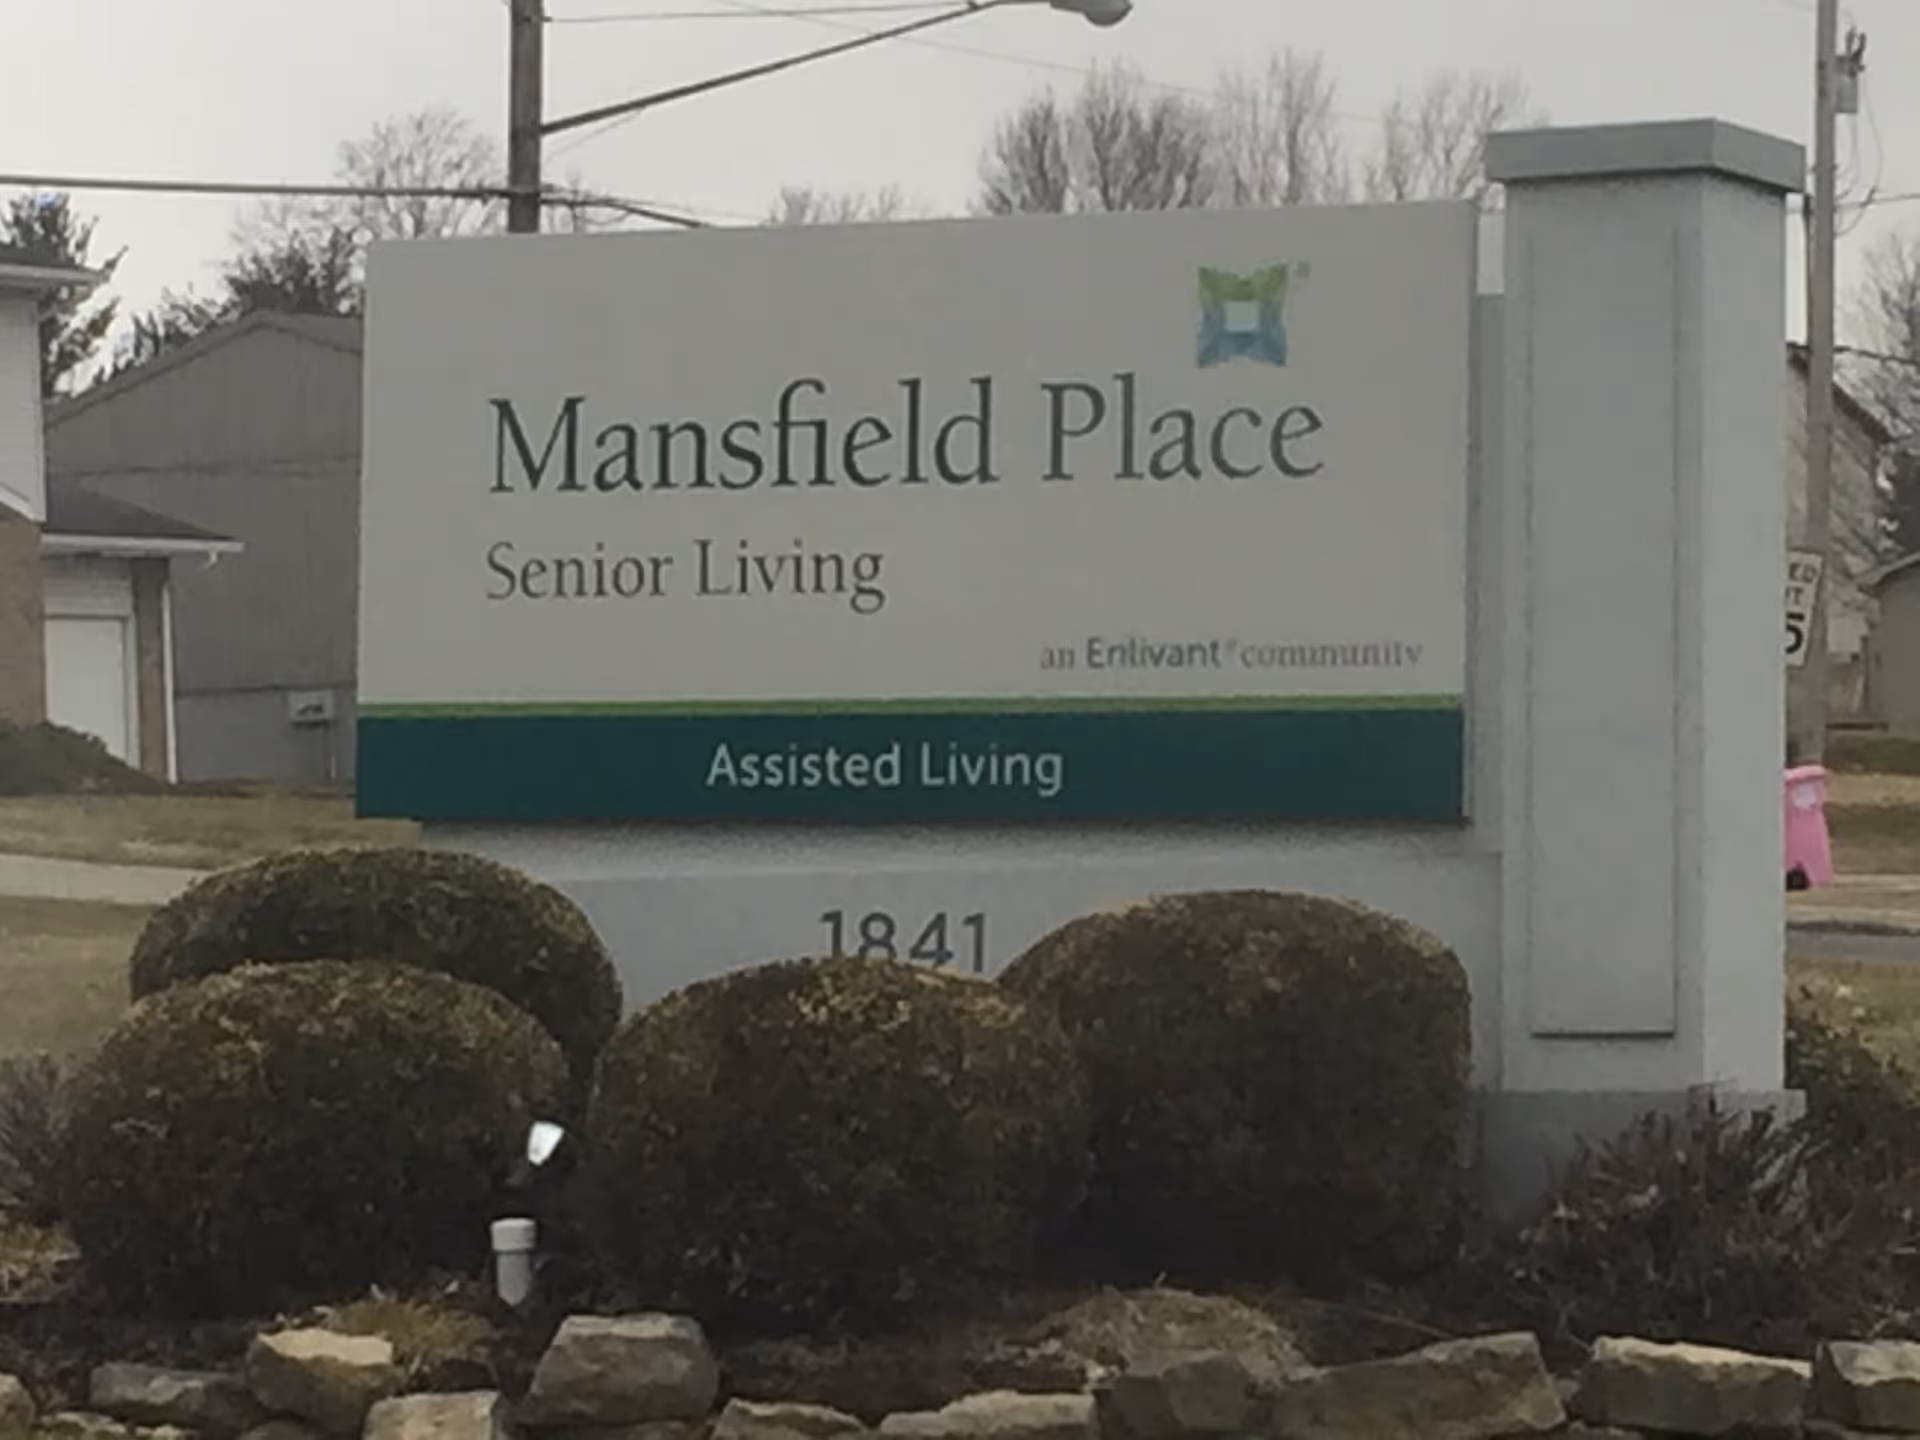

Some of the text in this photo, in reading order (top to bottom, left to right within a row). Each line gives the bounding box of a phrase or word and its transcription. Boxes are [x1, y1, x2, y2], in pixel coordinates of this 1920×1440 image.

[488, 372, 1325, 494] Mansfield Place
[486, 538, 887, 615] Senior Living
[1039, 646, 1076, 671] an
[1239, 640, 1424, 669] community
[706, 742, 1064, 797] Assisted Living
[819, 909, 986, 972] 1841
